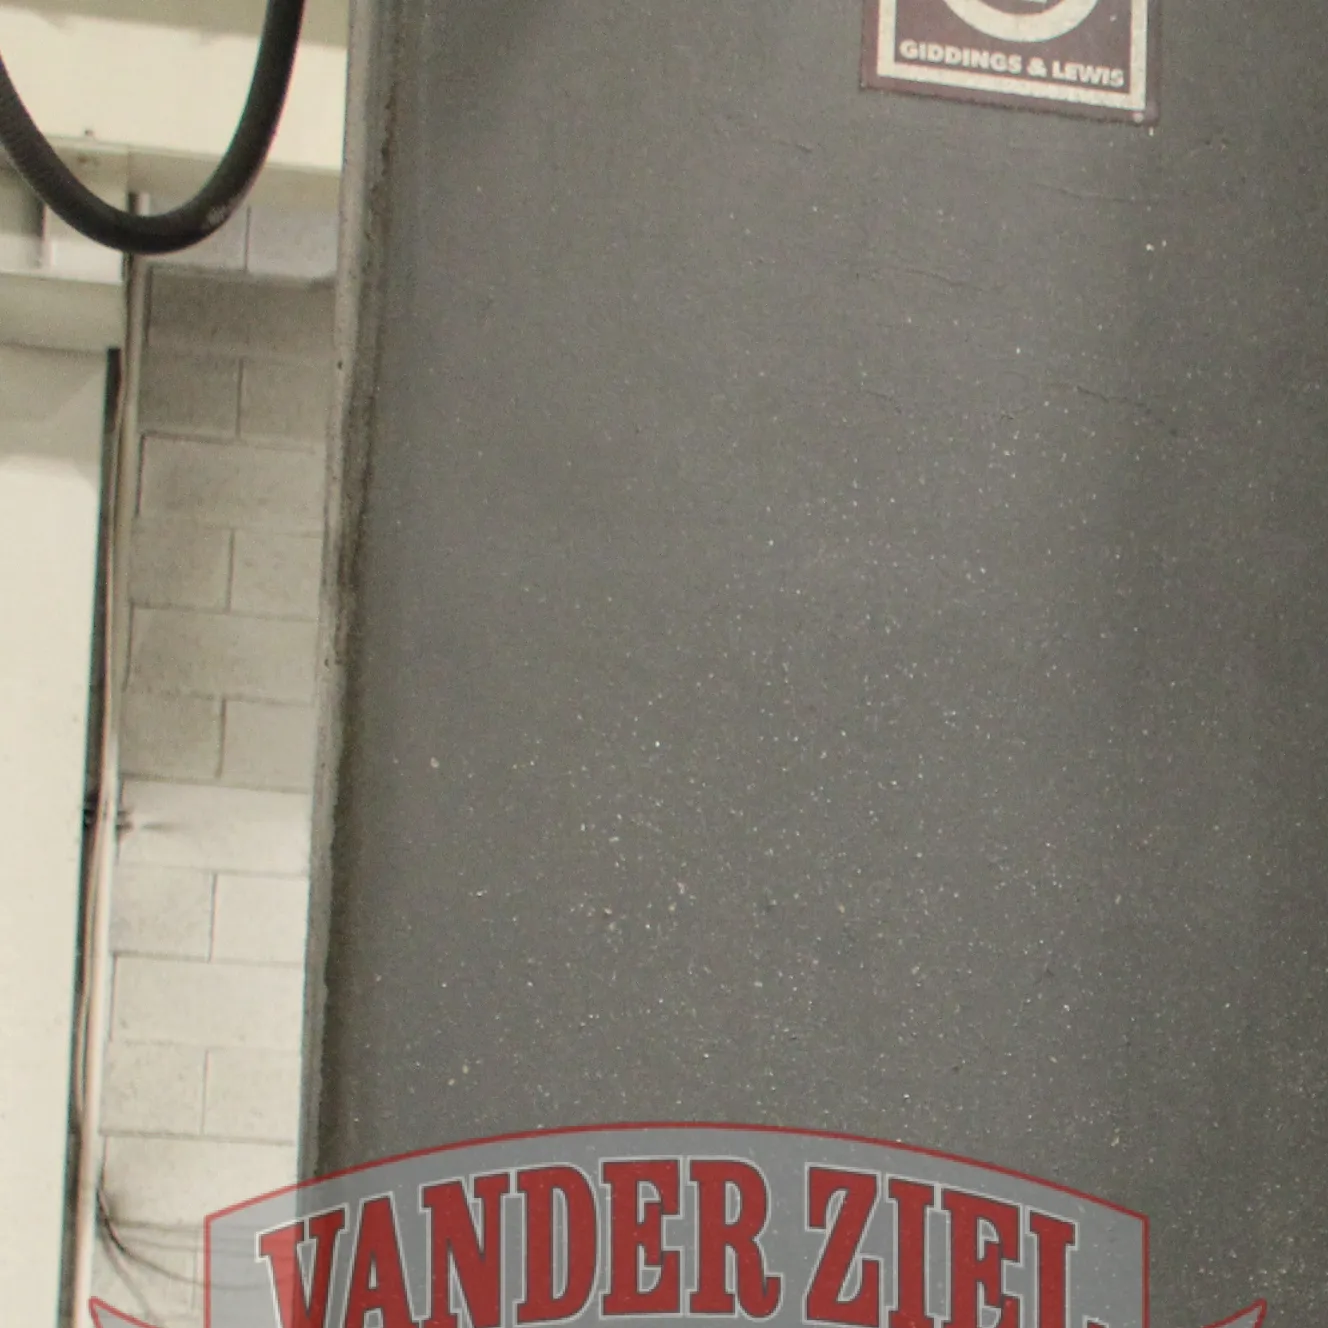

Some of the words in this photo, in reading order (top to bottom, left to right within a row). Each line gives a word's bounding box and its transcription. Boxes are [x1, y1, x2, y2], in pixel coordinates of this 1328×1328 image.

[900, 39, 1022, 75] GIDDINGS
[1027, 57, 1048, 77] &
[1053, 60, 1125, 88] LEWIS
